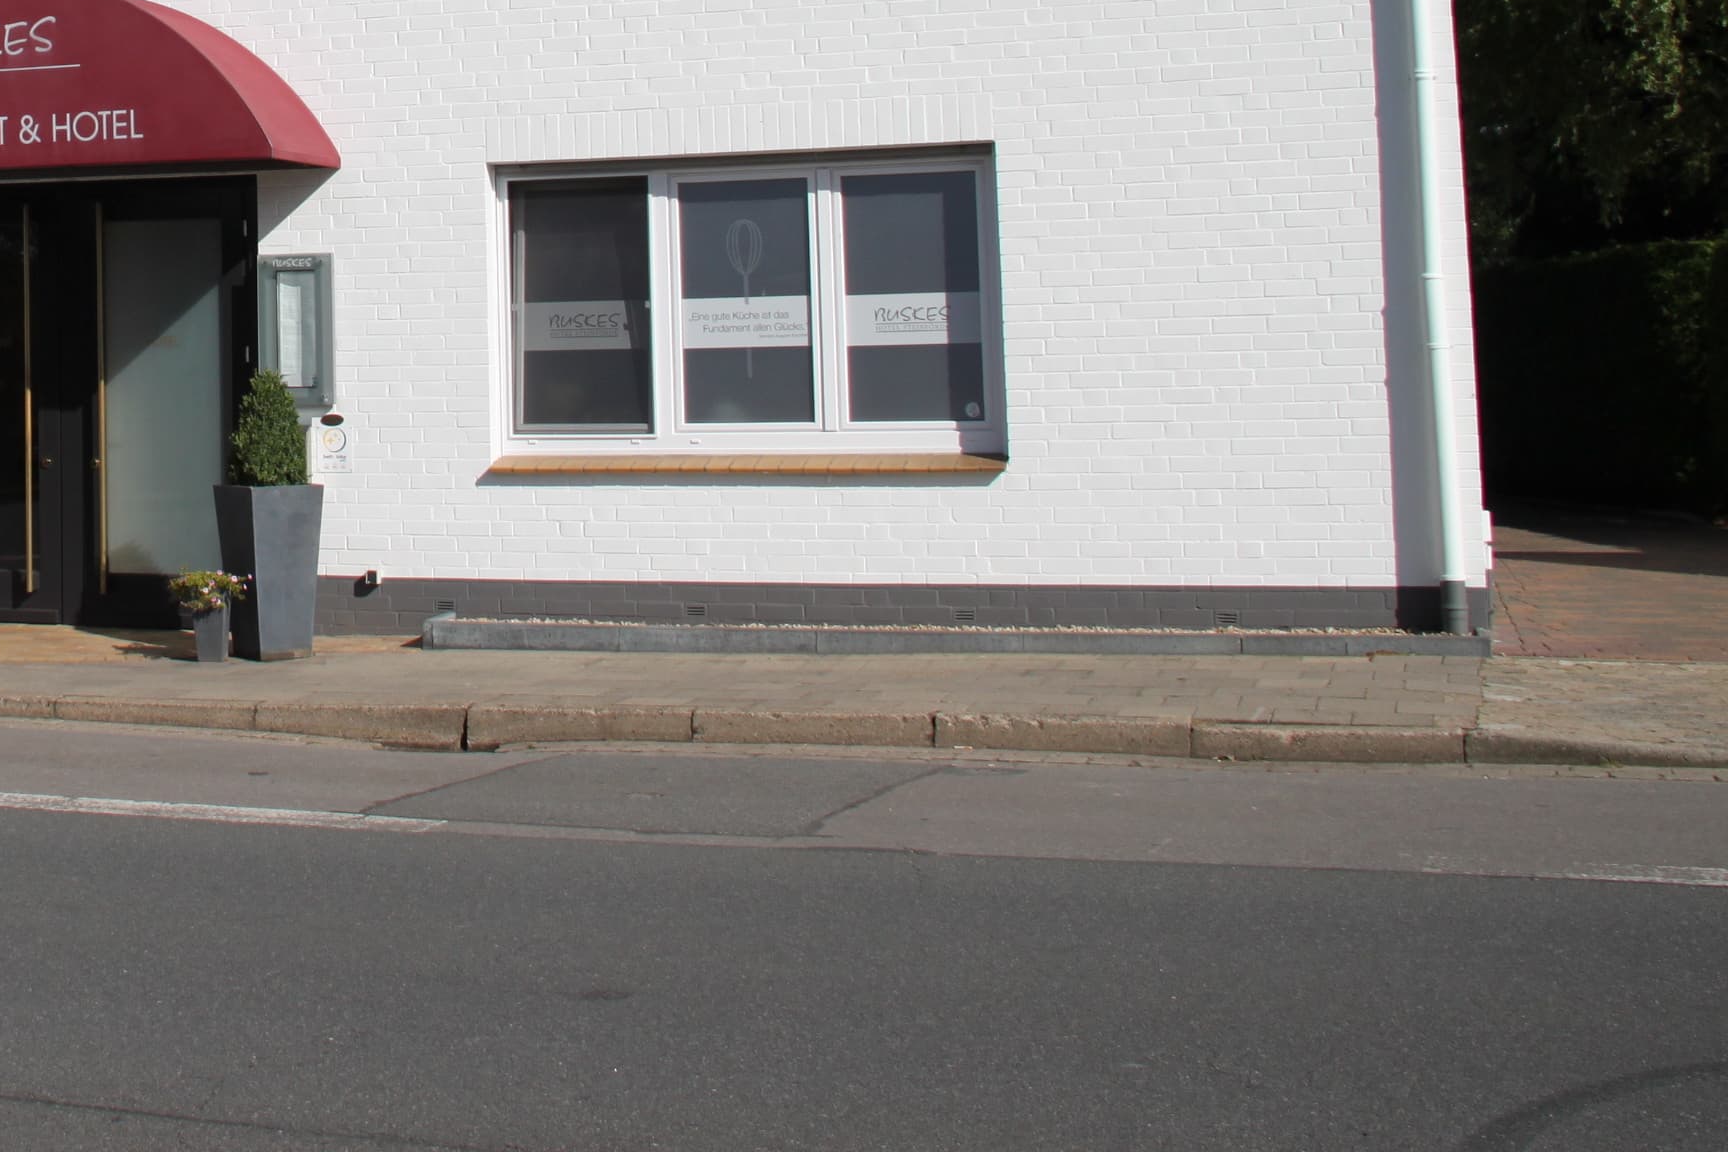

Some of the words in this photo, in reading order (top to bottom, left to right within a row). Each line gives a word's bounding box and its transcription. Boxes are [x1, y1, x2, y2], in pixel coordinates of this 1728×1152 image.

[19, 114, 40, 144] &
[52, 108, 144, 142] HOTEL
[548, 312, 621, 328] BUSKES
[873, 305, 952, 322] BUSKES
